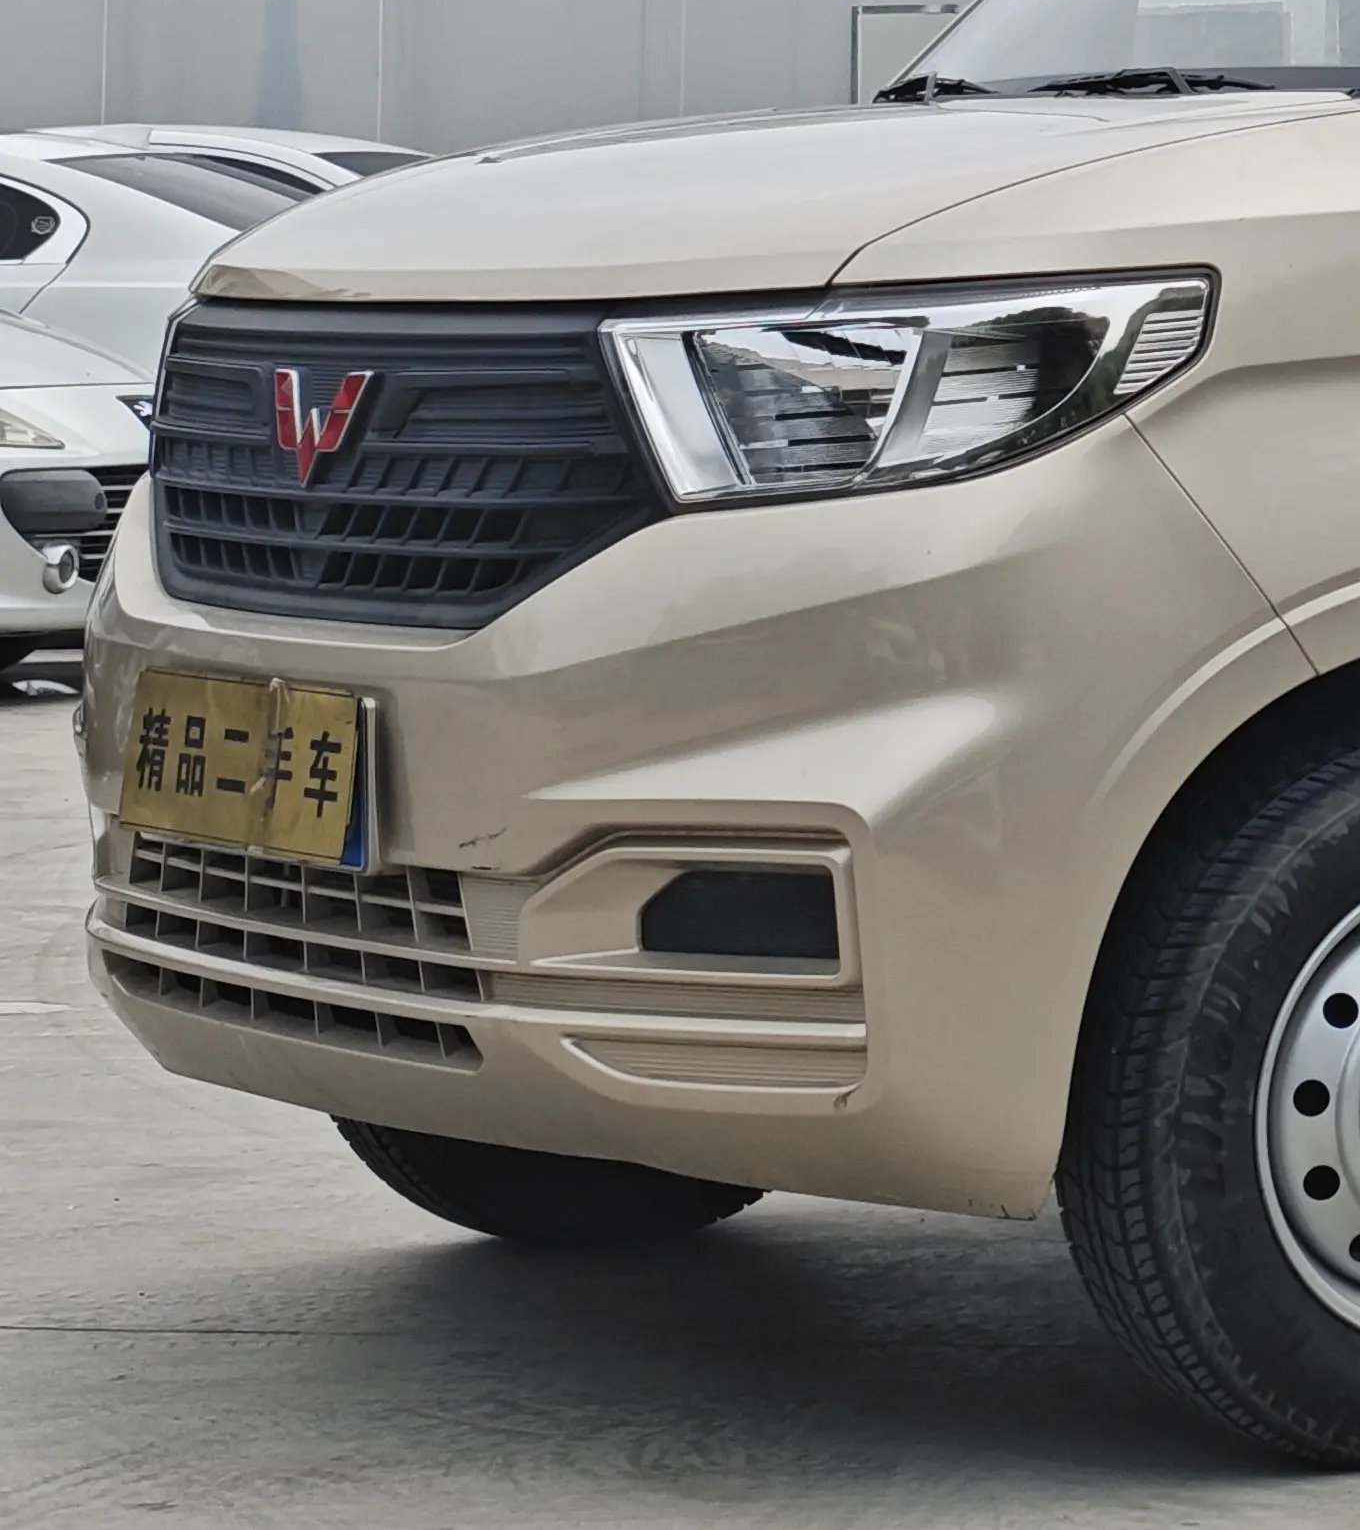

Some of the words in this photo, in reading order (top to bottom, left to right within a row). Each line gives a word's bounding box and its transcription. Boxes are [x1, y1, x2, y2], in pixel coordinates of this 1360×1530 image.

[136, 707, 342, 818] 精品二手车
